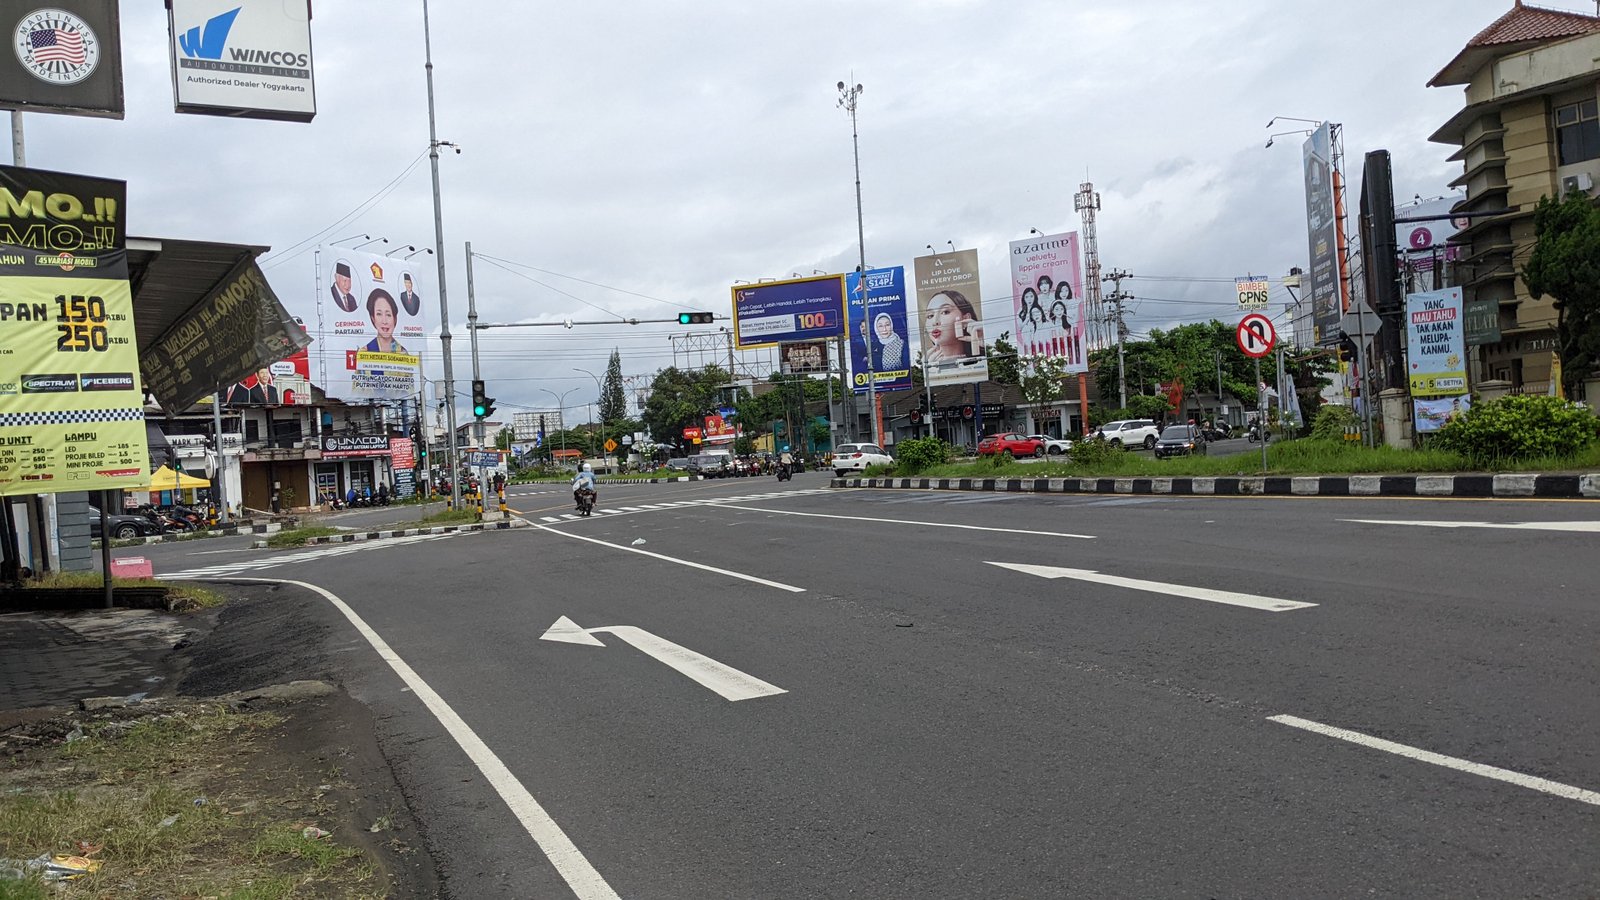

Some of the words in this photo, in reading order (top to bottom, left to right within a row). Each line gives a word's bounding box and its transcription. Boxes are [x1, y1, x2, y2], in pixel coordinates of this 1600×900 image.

[20, 13, 50, 36] MADE
[58, 14, 71, 22] IN
[76, 23, 94, 46] USA
[229, 48, 308, 67] WINCOS
[24, 56, 53, 79] MADE
[73, 62, 92, 78] USA
[187, 60, 263, 74] AUTOMOTIVE
[272, 68, 306, 78] FILMS
[187, 76, 232, 86] Authorized
[234, 80, 260, 88] Dealer
[262, 82, 305, 92] Yogyakarta
[1416, 234, 1426, 244] 4
[1026, 252, 1056, 262] velvety
[1018, 263, 1040, 272] lippie
[1042, 259, 1068, 268] cream
[930, 276, 951, 284] EVERY
[1238, 282, 1268, 291] BIMBEL
[1239, 290, 1268, 304] CPNS
[55, 295, 106, 323] 150
[1424, 299, 1444, 310] YANG
[0, 303, 48, 322] PAN
[1413, 312, 1432, 322] MAU
[1433, 310, 1456, 320] TAHU,
[798, 312, 824, 328] 100
[1416, 324, 1432, 334] TAK
[1432, 322, 1454, 332] AKAN
[57, 325, 108, 352] 250
[1420, 333, 1452, 344] MELUPA-
[1421, 344, 1452, 356] KANMU.
[856, 374, 864, 384] 3
[1412, 380, 1418, 388] 4
[1429, 379, 1434, 388] 5
[8, 436, 32, 444] UNIT
[65, 432, 97, 441] LAMPU
[338, 437, 387, 445] UNACOM
